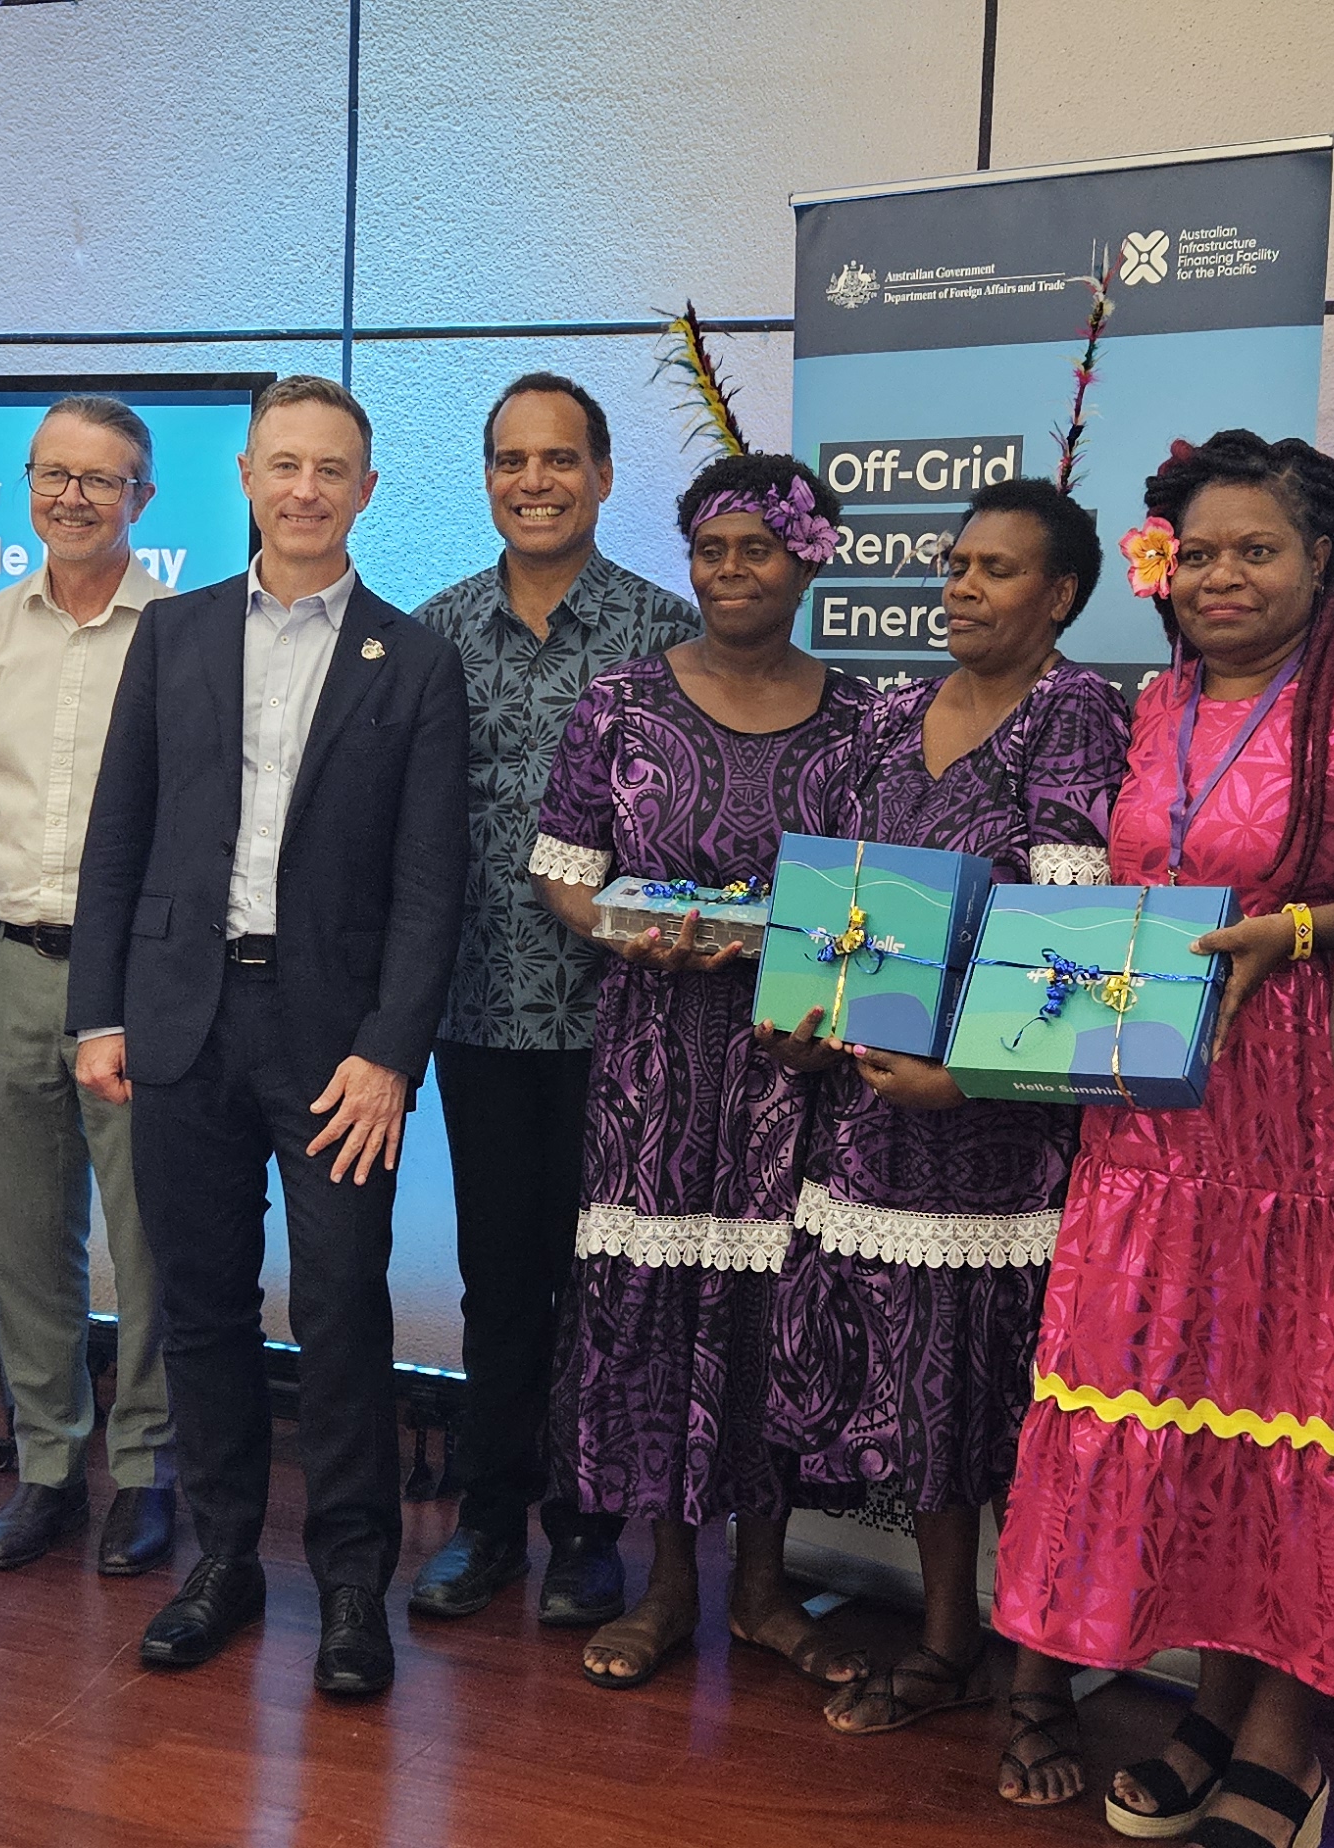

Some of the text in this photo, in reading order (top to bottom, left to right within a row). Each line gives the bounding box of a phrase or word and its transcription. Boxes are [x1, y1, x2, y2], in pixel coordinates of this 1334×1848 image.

[1179, 226, 1238, 241] Australian
[1178, 239, 1257, 254] Infrastructure
[1178, 248, 1280, 267] Financing Facility
[884, 263, 996, 282] Australian Government
[1177, 263, 1257, 280] for the Pacific
[883, 279, 1066, 305] Department of Foreign Affairs and Trade
[828, 445, 1015, 493] Off-Grid
[1013, 1082, 1055, 1092] Hello
